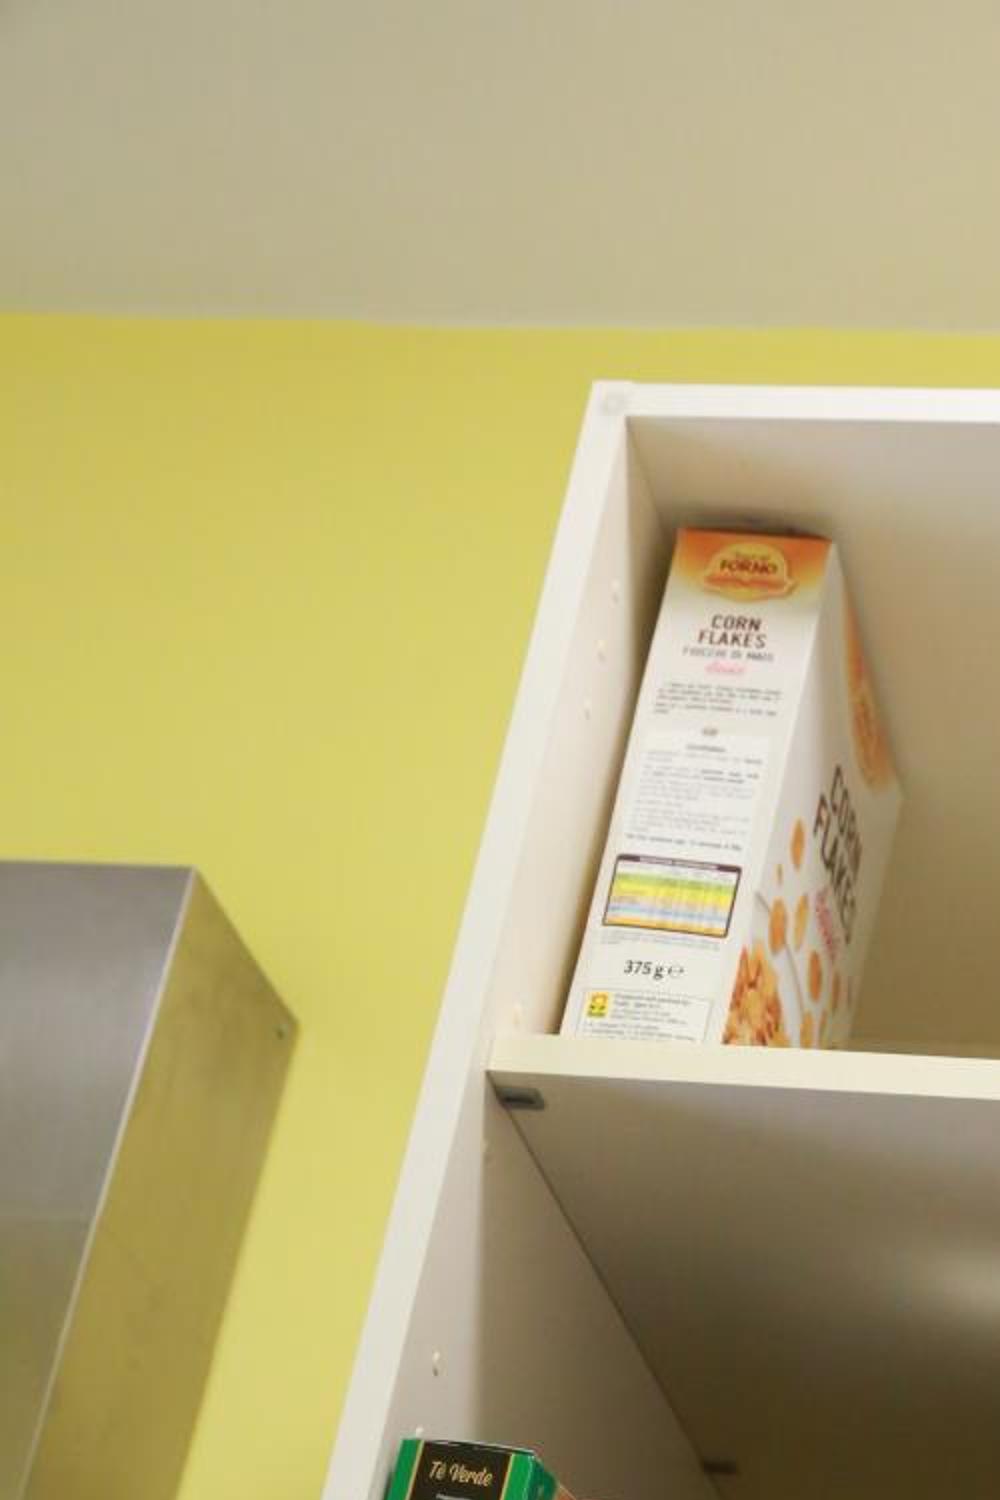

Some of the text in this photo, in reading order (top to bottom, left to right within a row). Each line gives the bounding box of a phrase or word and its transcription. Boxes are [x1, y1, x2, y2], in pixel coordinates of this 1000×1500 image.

[711, 614, 762, 632] CORN
[698, 629, 767, 649] FLAKES
[623, 959, 664, 980] 375 g
[449, 1462, 494, 1487] Verde
